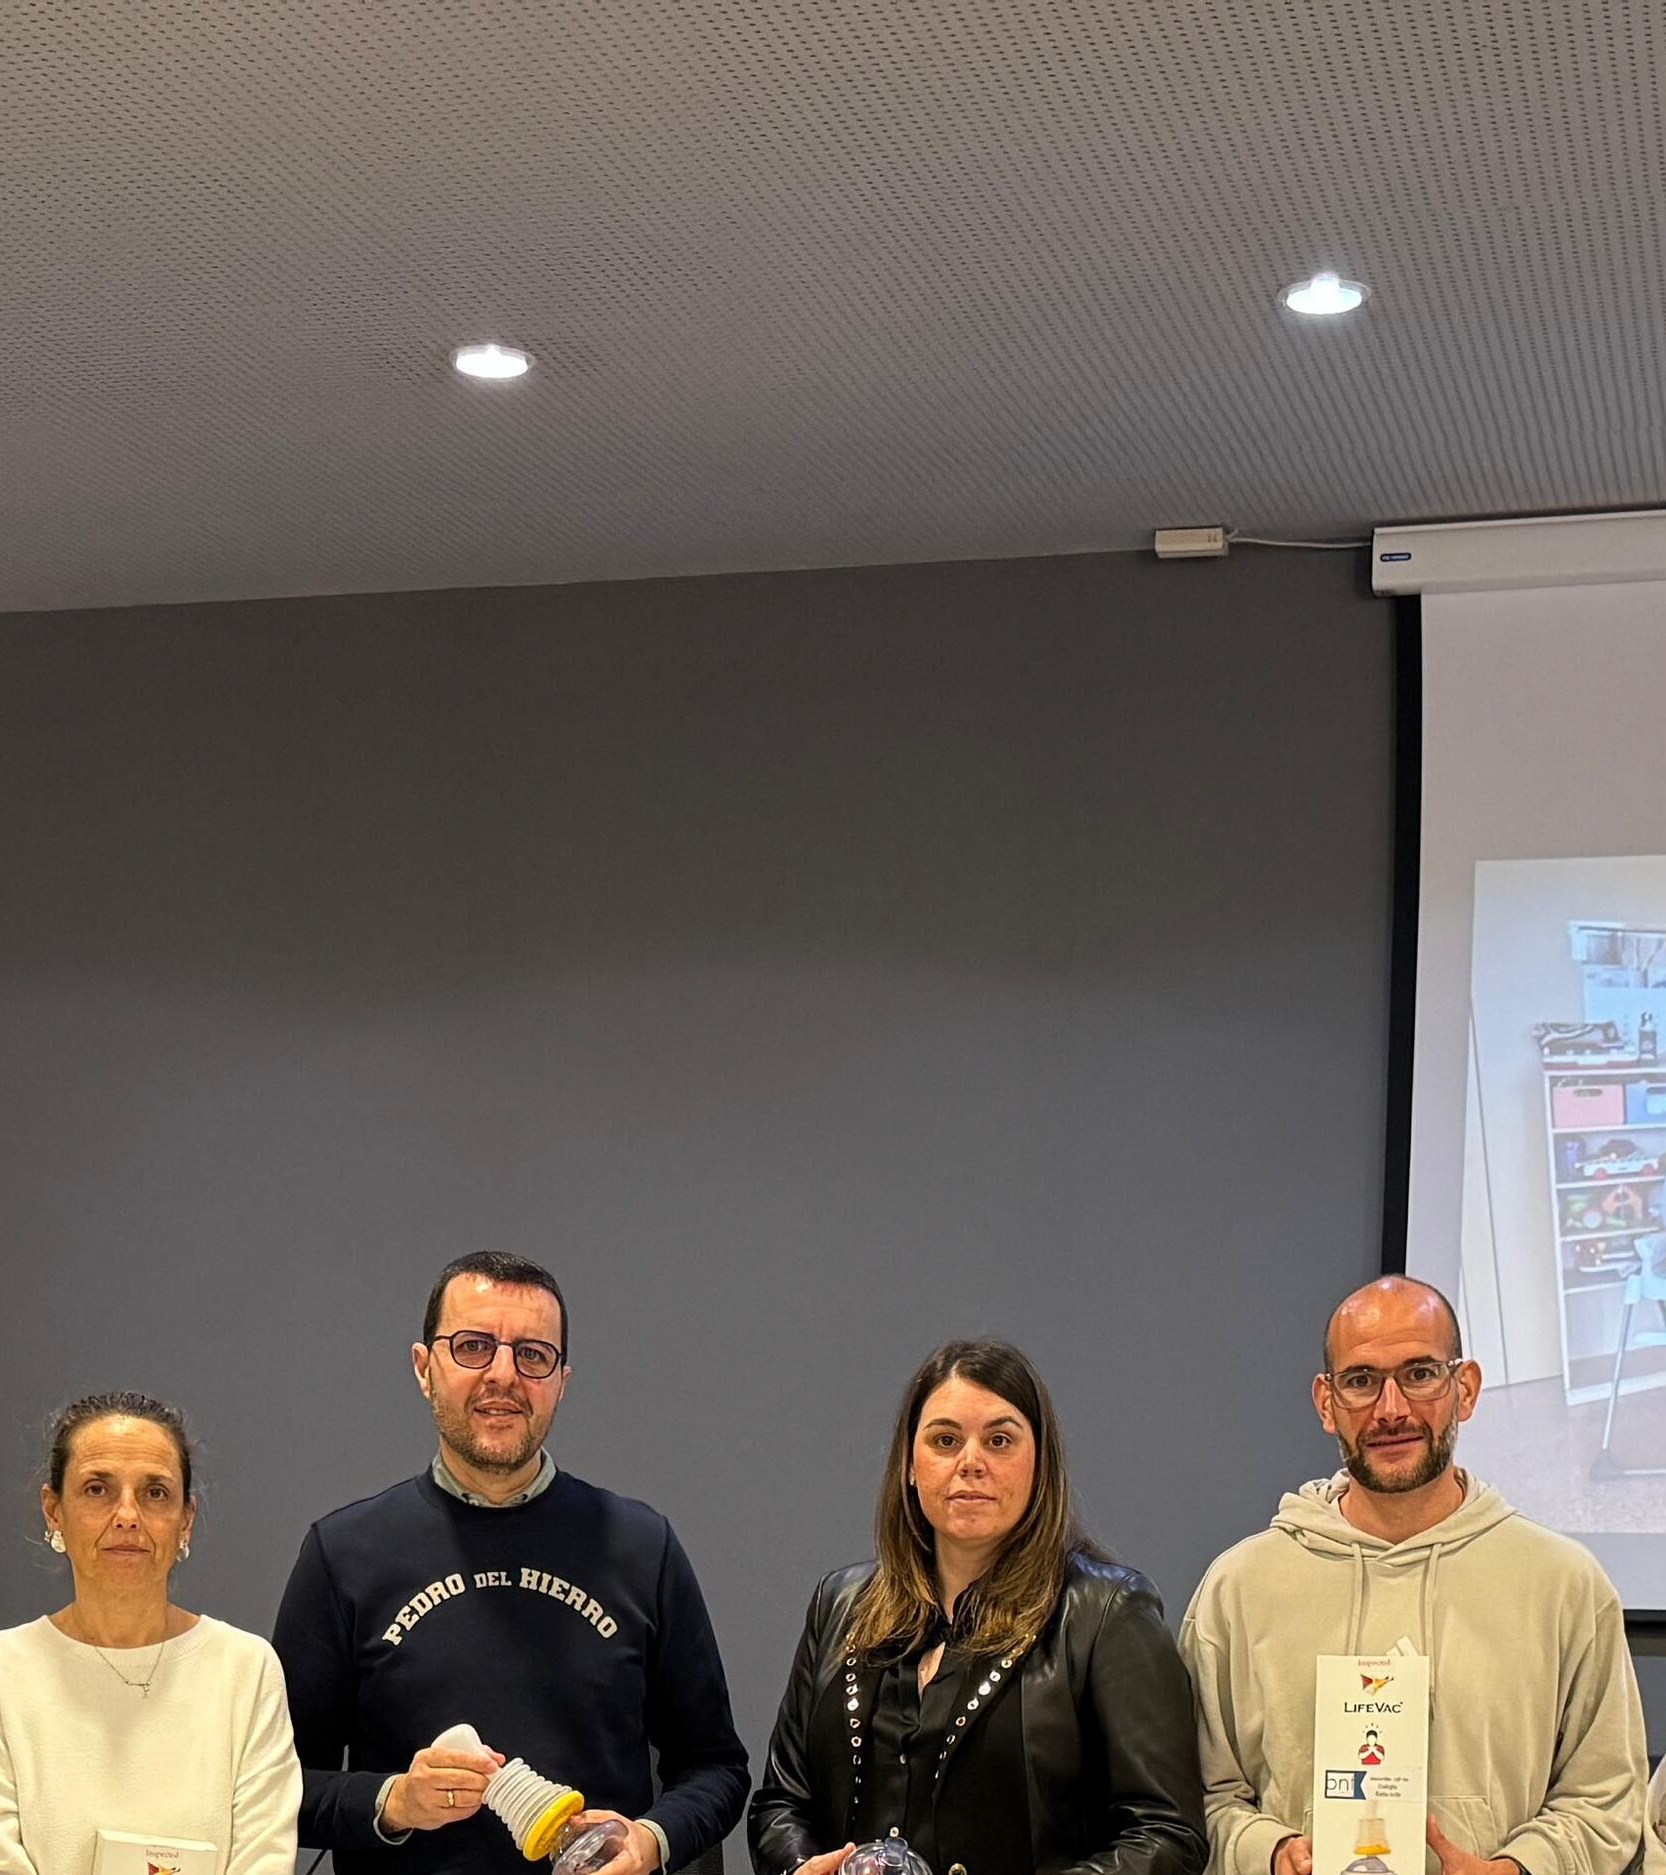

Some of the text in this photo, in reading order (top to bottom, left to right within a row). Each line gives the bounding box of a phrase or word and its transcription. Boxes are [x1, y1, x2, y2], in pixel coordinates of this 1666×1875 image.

[382, 1567, 618, 1646] PEDRO DEL HIERRO
